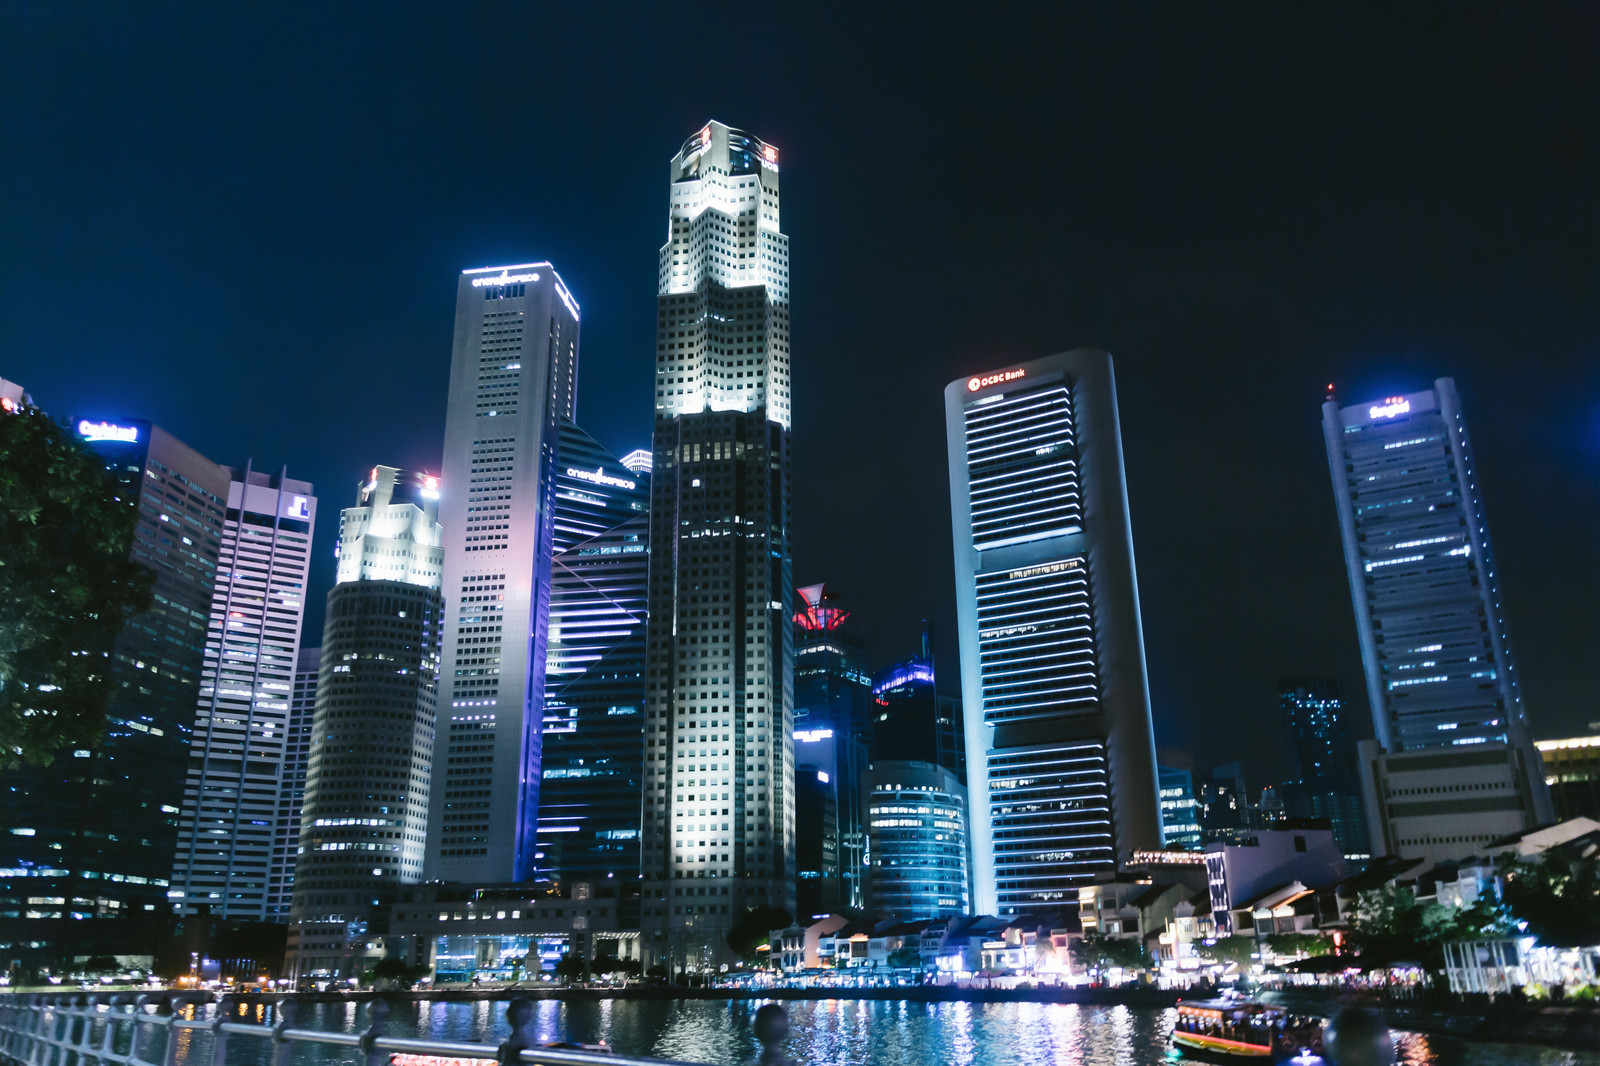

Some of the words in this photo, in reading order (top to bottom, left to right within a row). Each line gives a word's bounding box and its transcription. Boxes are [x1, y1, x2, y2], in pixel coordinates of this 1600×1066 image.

[761, 159, 779, 173] UOB
[981, 373, 1005, 387] OCBC
[1005, 368, 1026, 381] Bank
